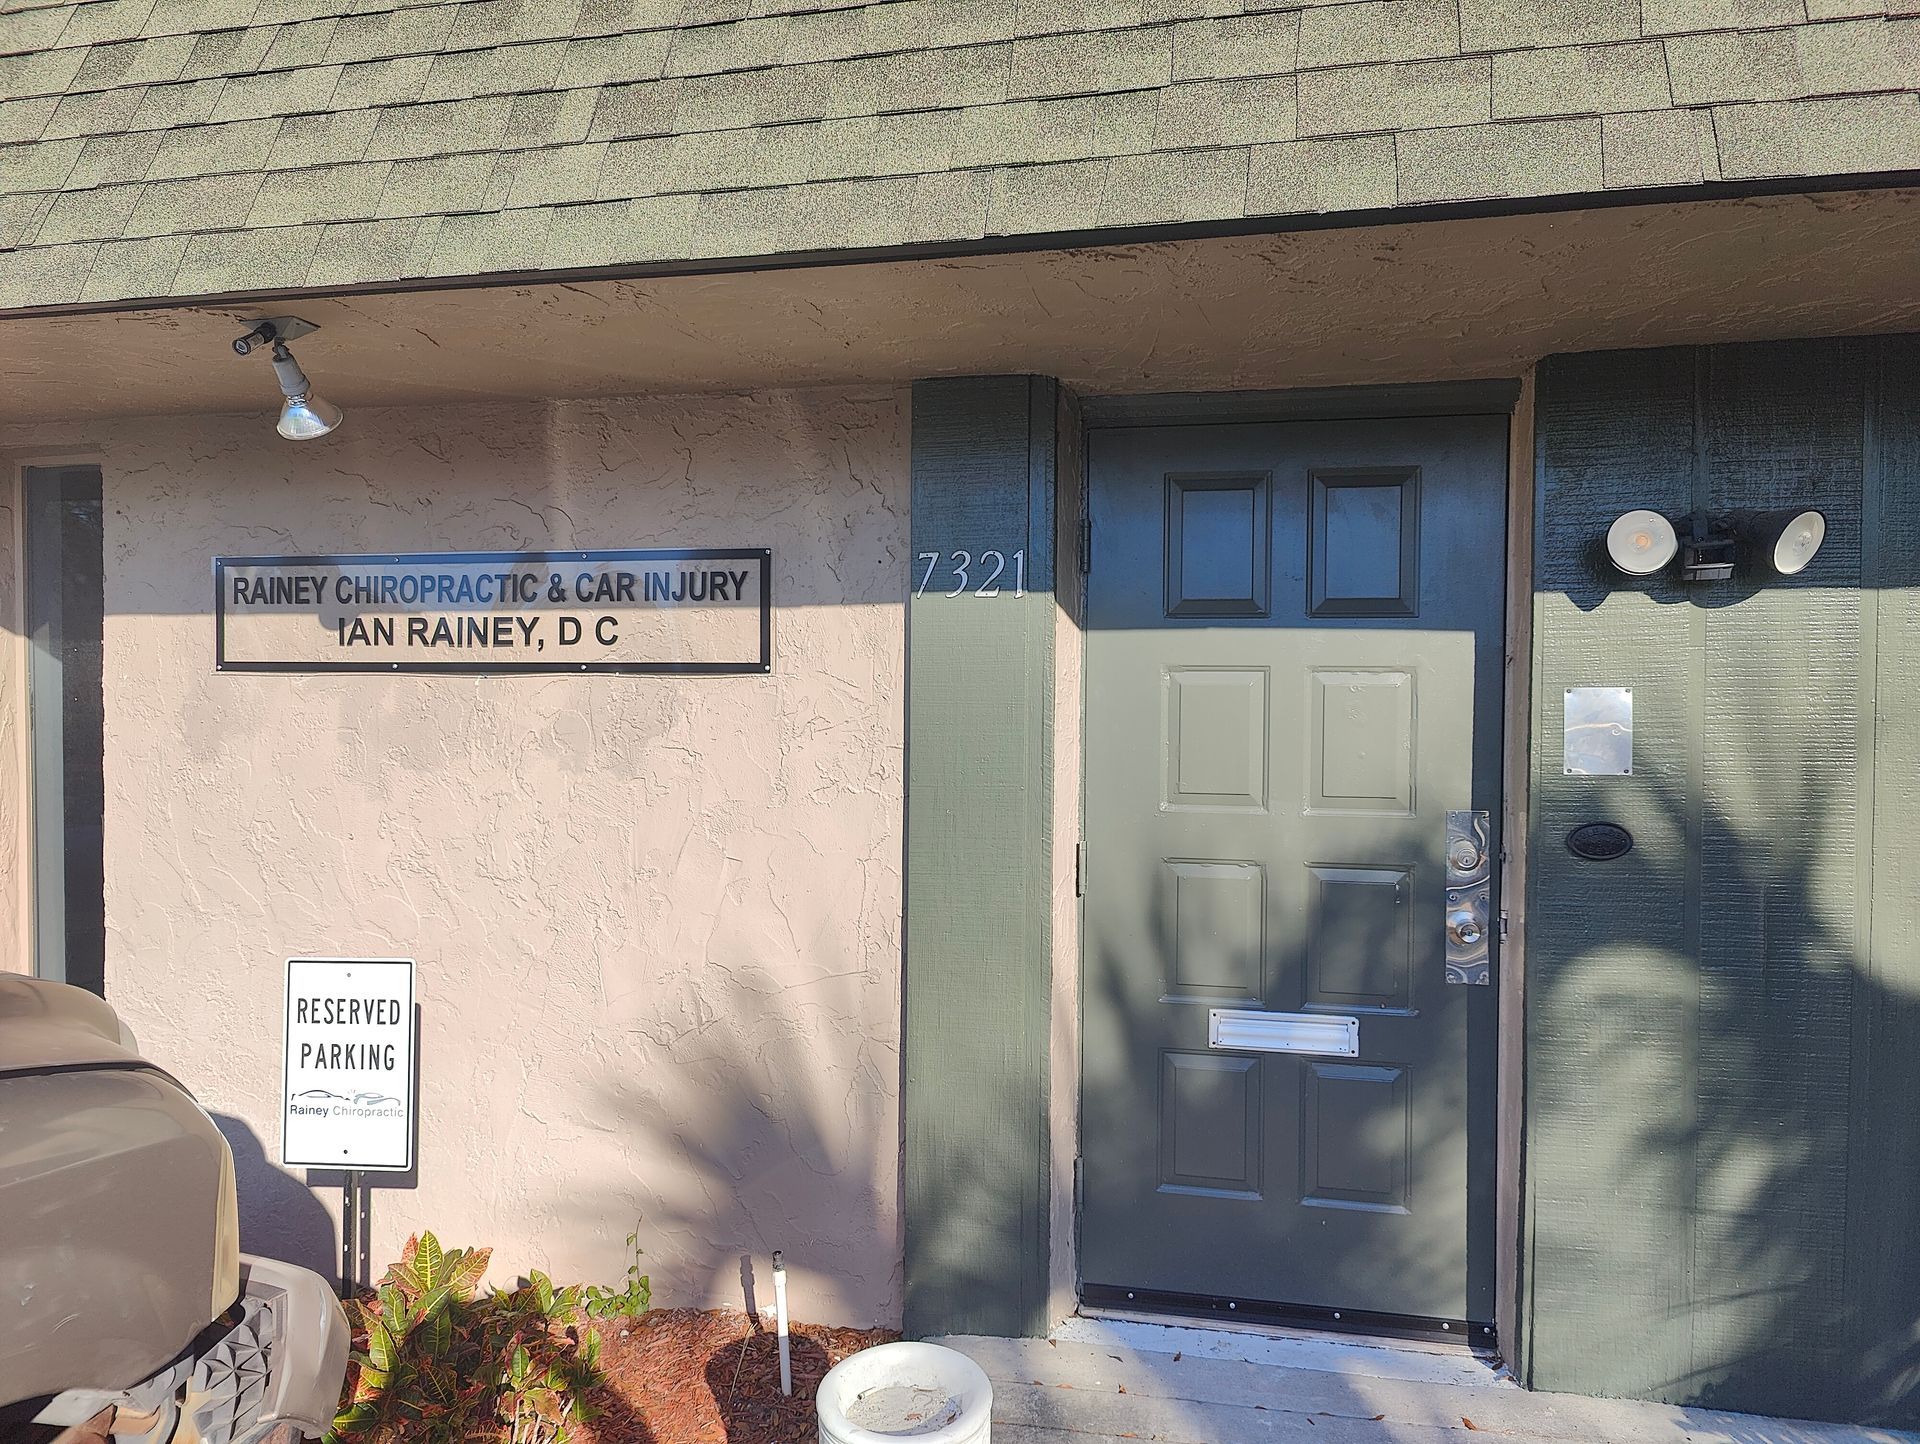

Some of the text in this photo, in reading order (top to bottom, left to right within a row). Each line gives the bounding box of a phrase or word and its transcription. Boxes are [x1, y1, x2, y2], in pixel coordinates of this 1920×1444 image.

[233, 570, 748, 605] RAINEY CHIROPRACTIC & CAR INJURY
[916, 549, 1024, 599] 7321
[338, 615, 619, 652] IAN RAINEY, D C
[297, 998, 401, 1025] RESERVED
[300, 1043, 395, 1071] PARKING
[289, 1104, 404, 1118] Rainey Chiropractic
